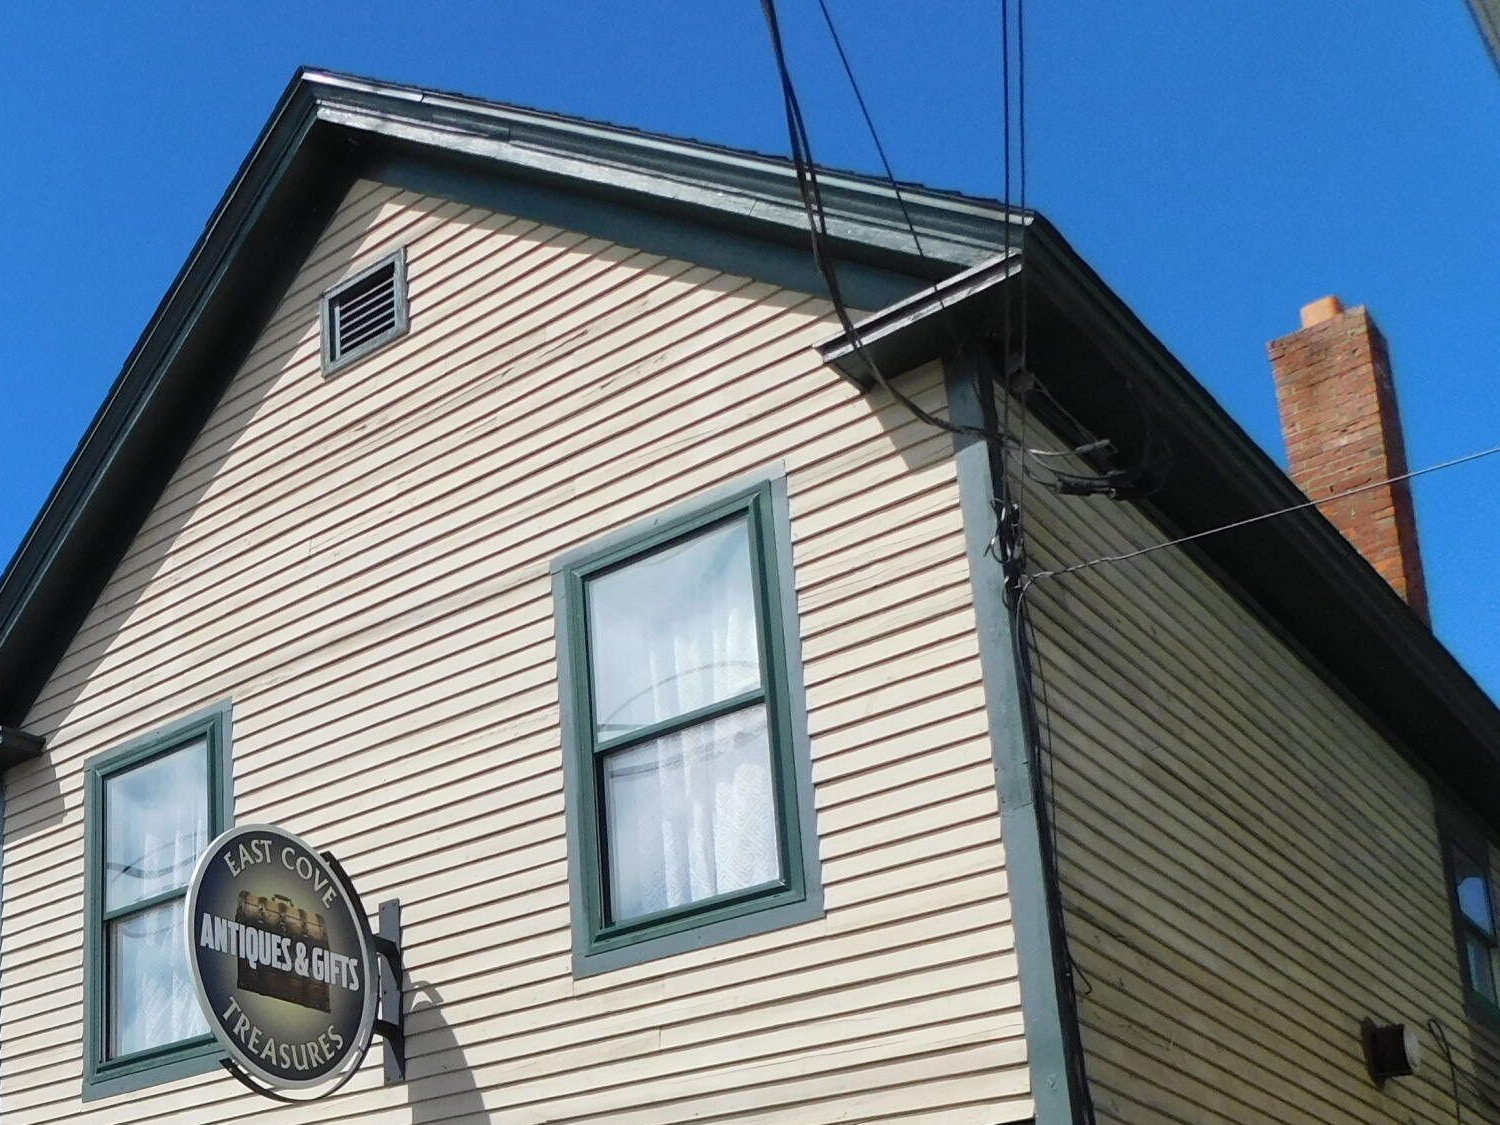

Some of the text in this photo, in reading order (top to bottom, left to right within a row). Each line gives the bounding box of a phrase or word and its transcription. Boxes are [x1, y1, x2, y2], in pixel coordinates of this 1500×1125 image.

[223, 839, 338, 909] EAST COVE
[200, 912, 360, 992] ANTIQUES & GIFTS
[221, 996, 344, 1071] TREASURES
